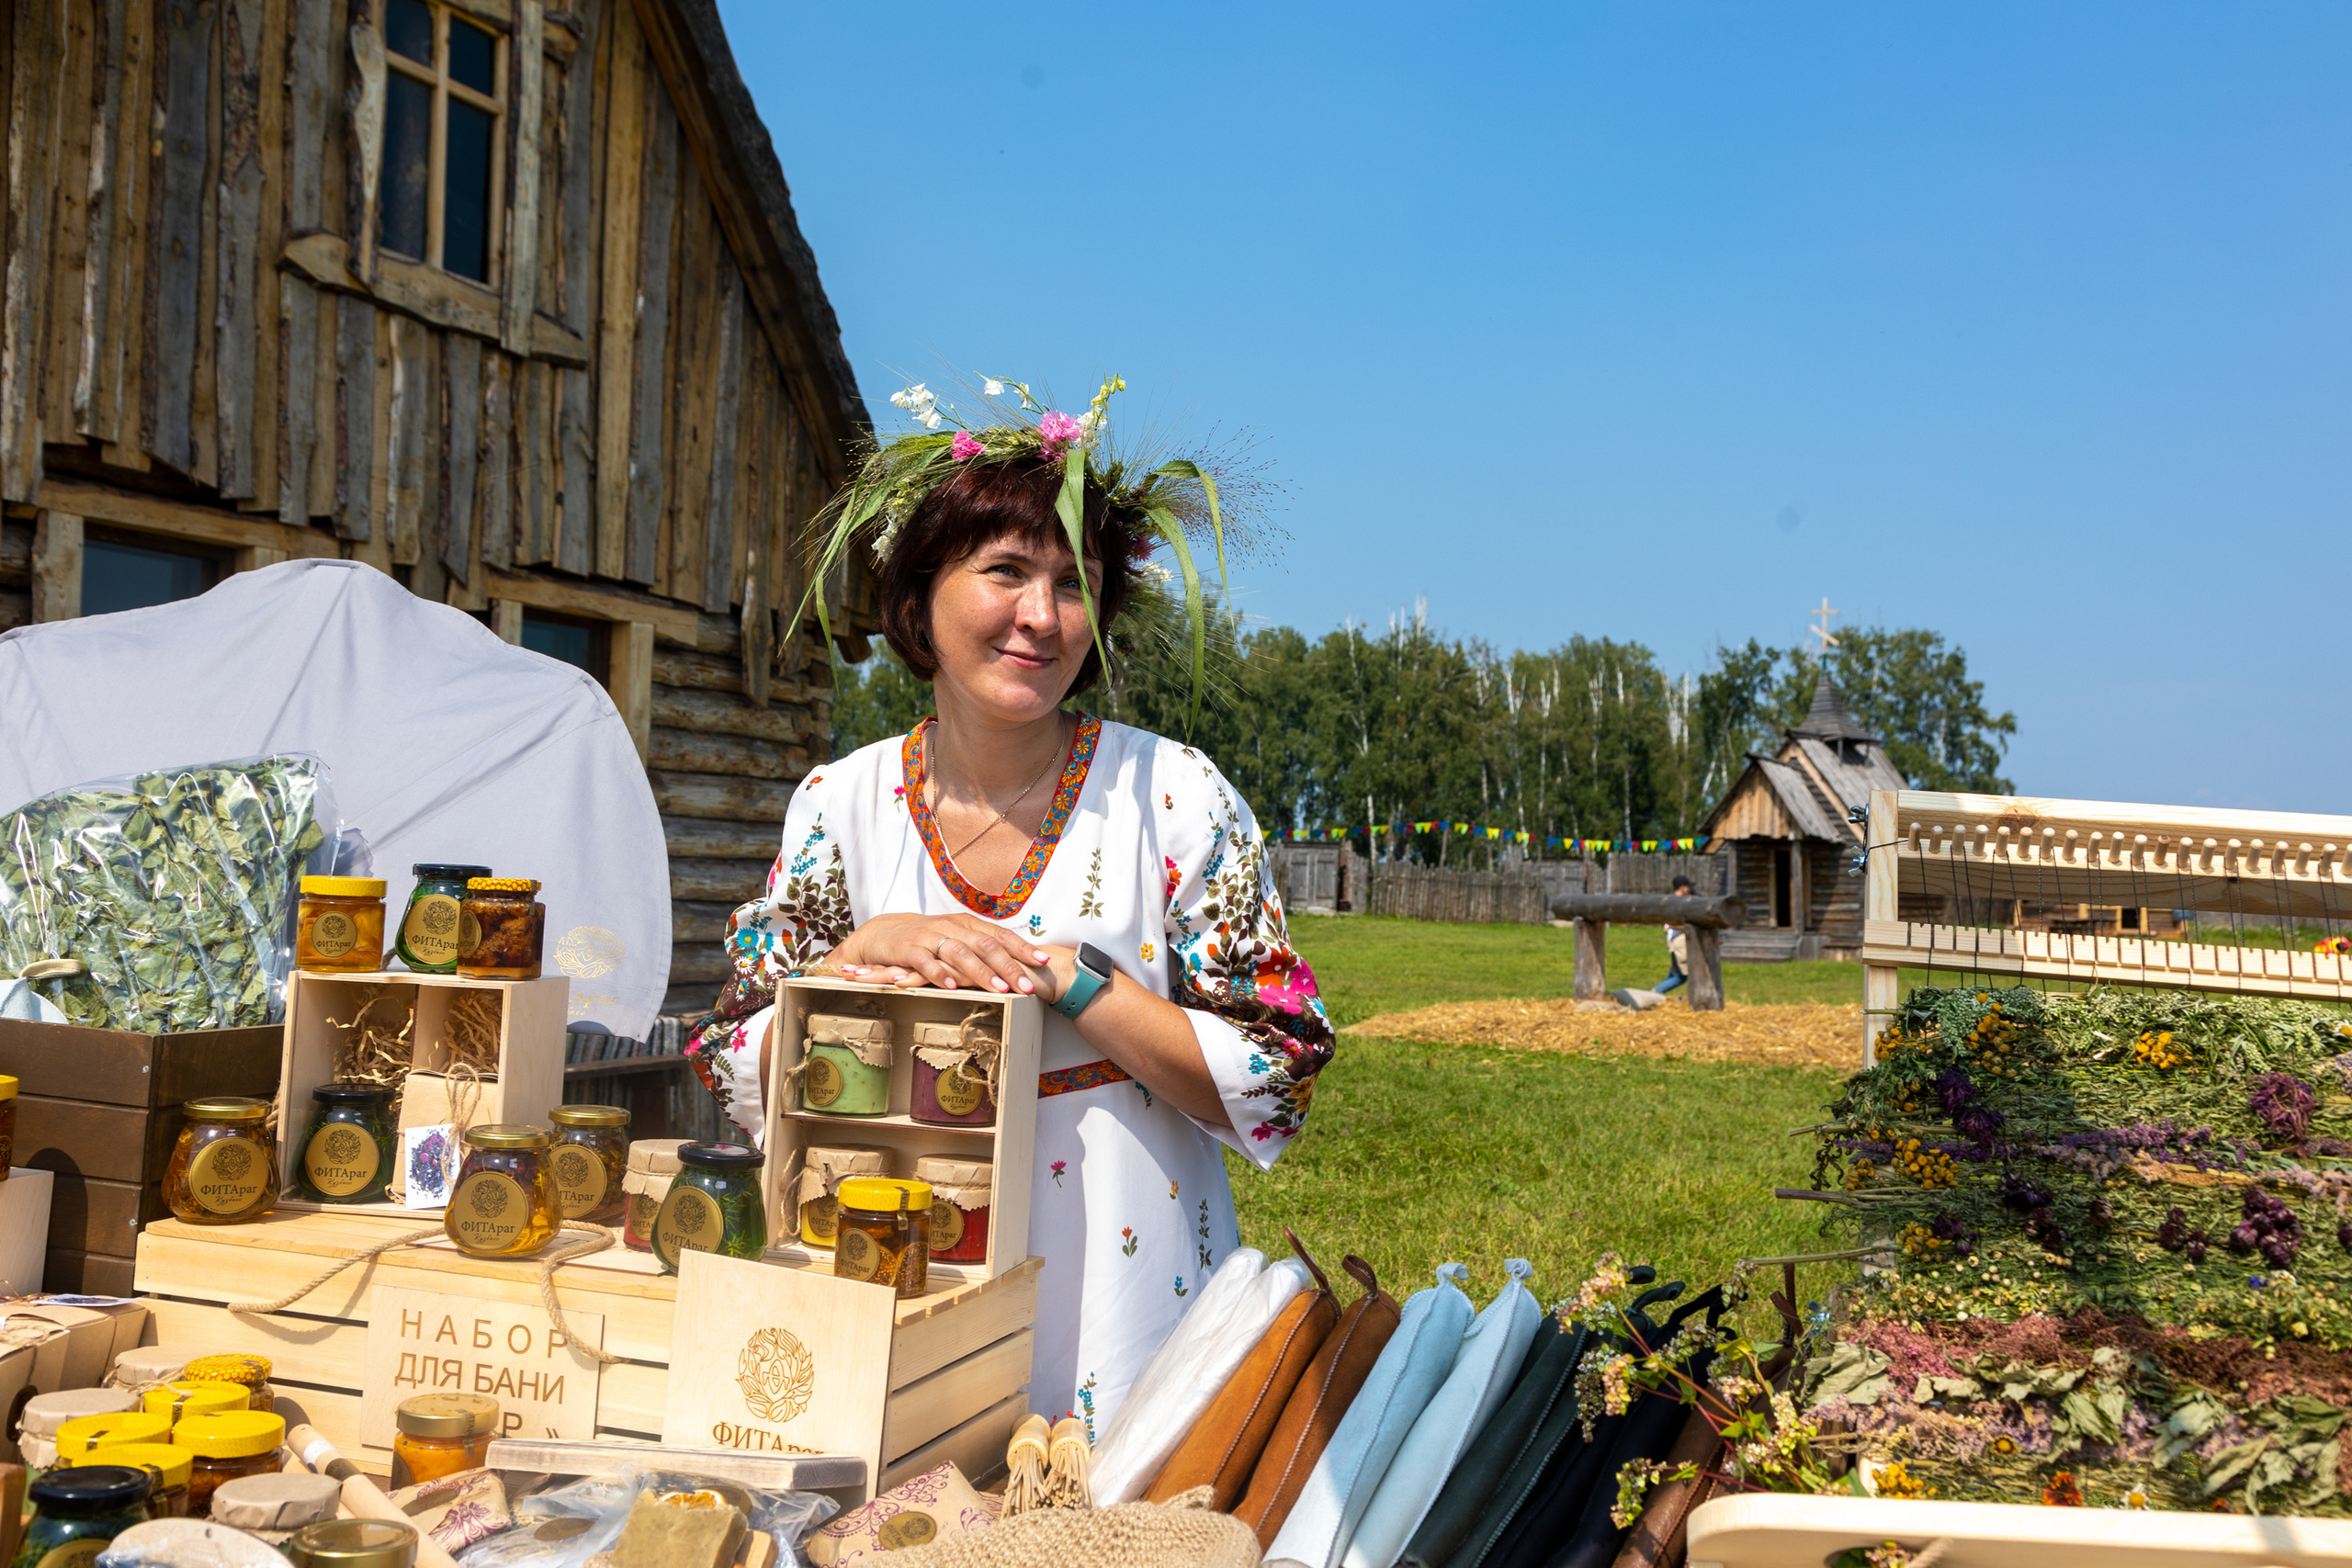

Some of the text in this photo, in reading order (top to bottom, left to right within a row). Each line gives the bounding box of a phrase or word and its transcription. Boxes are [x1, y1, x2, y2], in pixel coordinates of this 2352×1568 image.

[401, 1308, 568, 1359] НАБОР
[394, 1352, 565, 1405] ДЛЯ БАНИ
